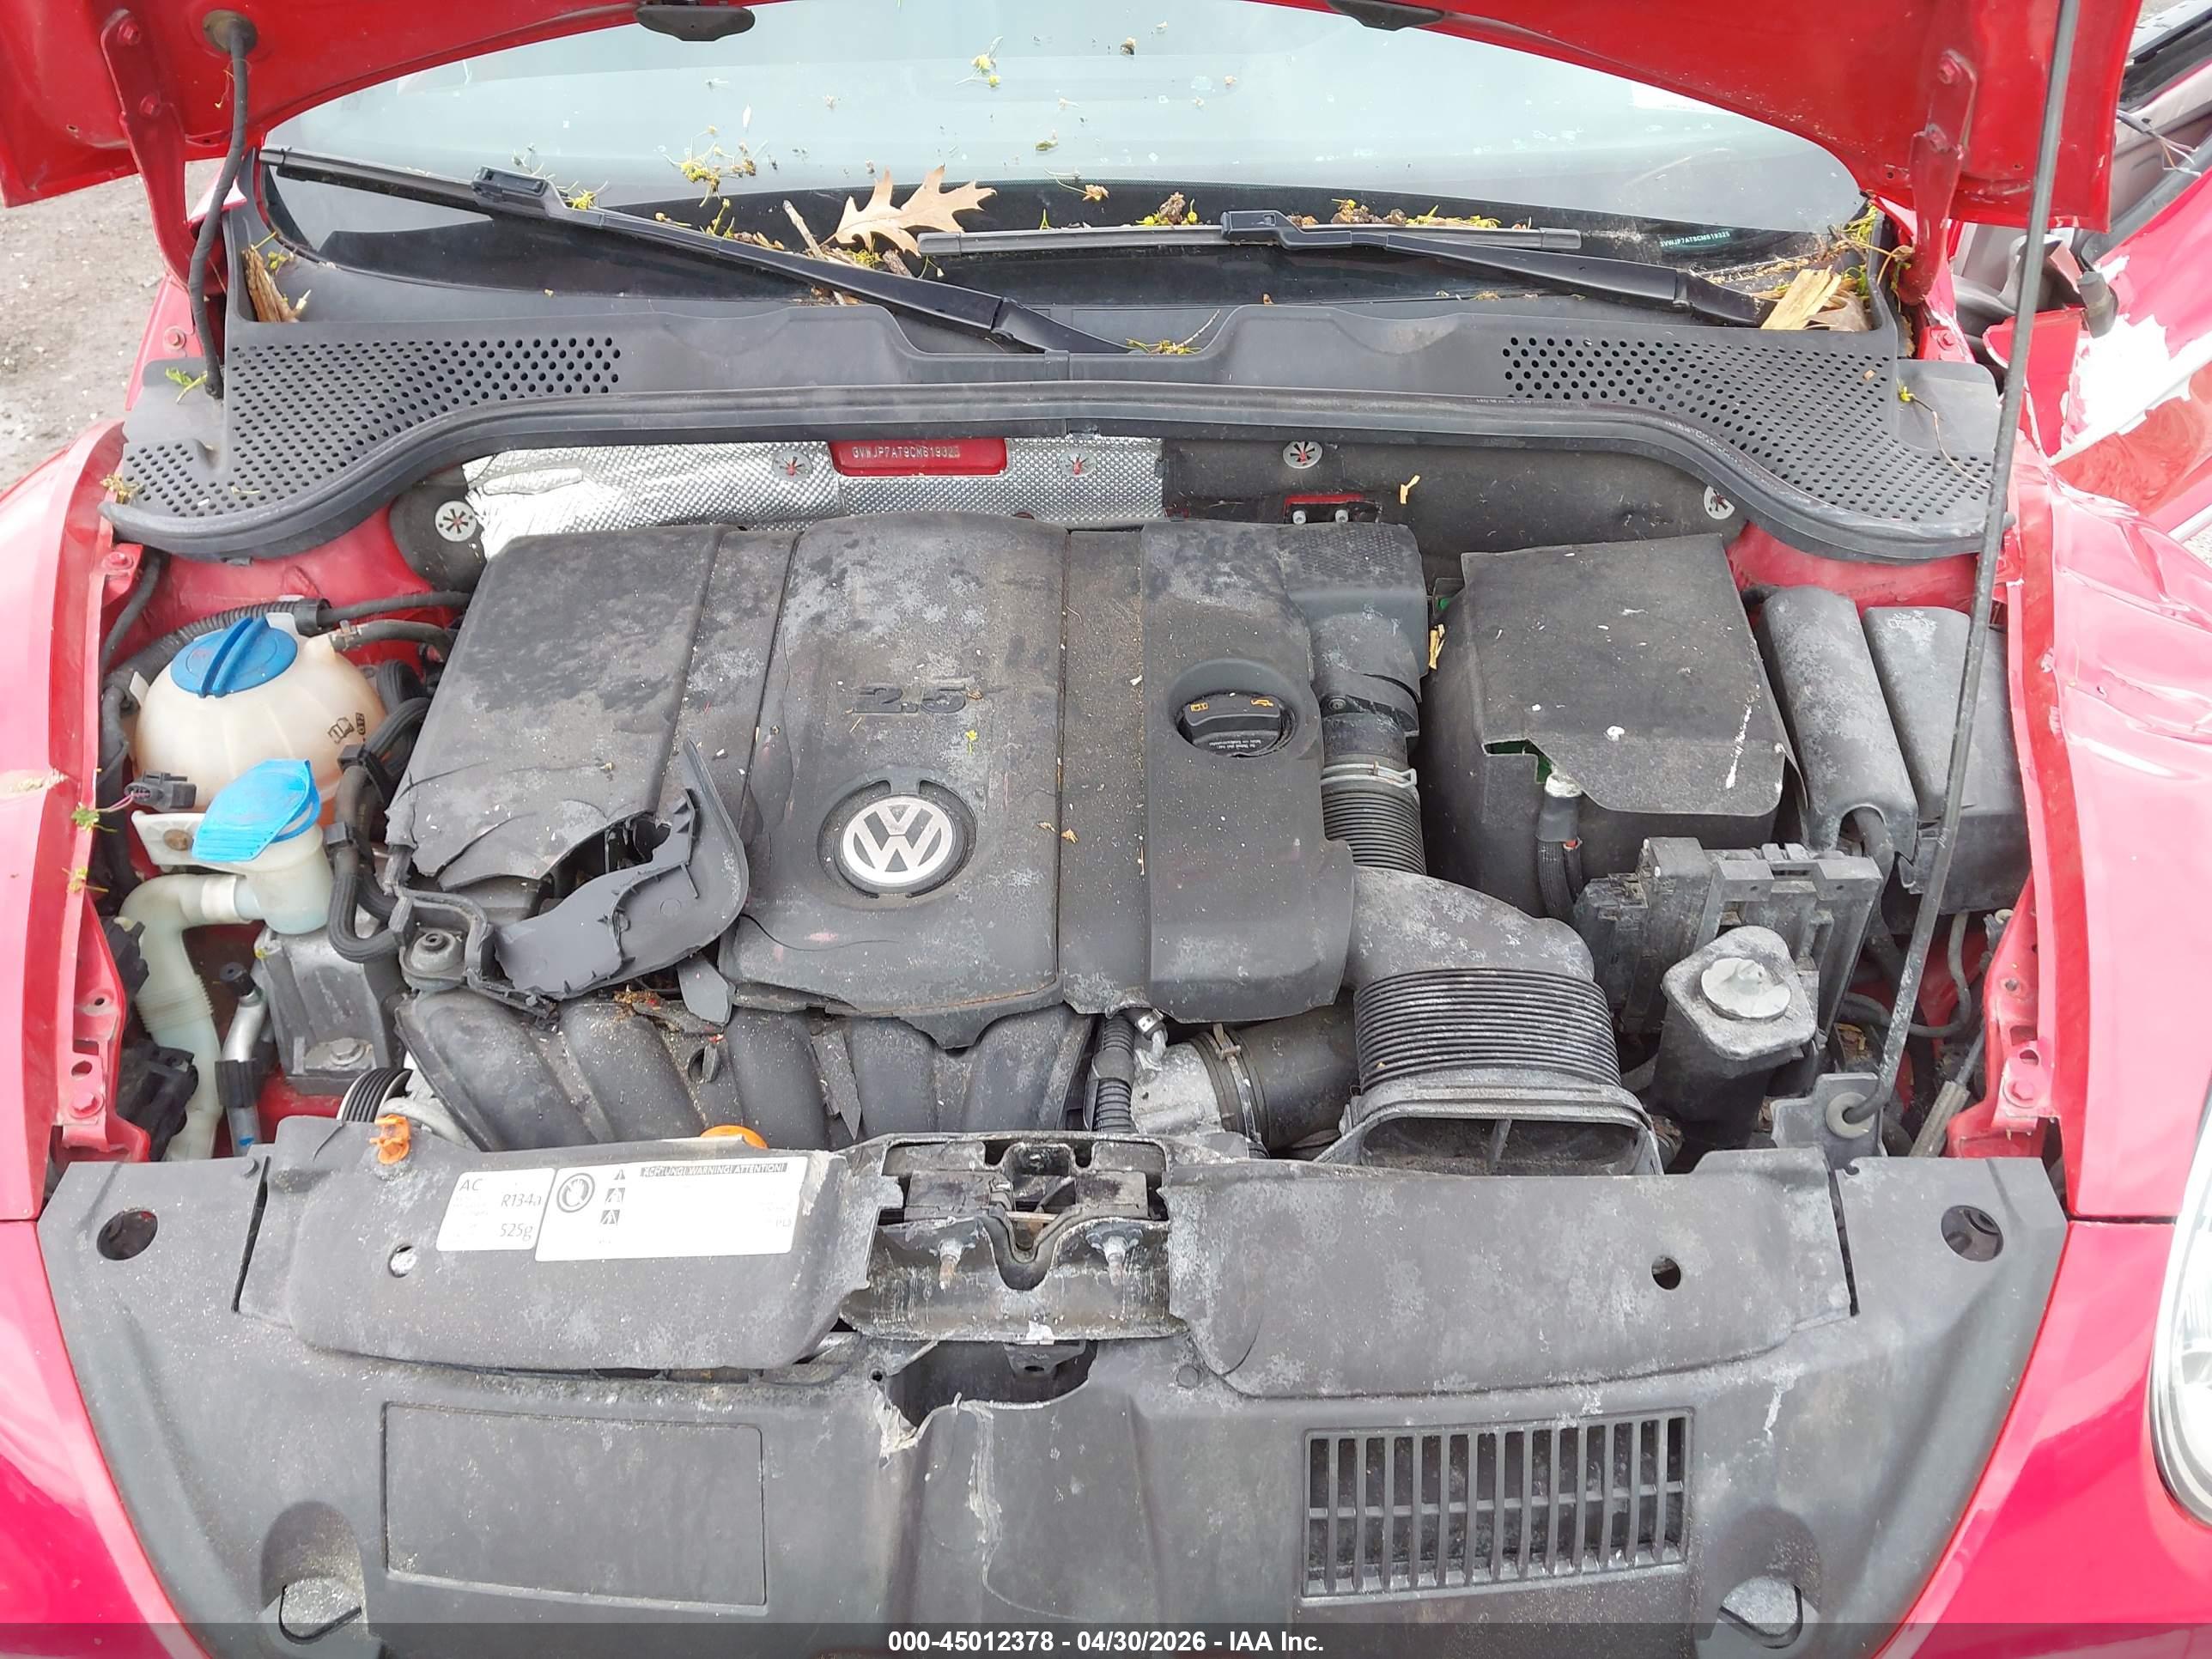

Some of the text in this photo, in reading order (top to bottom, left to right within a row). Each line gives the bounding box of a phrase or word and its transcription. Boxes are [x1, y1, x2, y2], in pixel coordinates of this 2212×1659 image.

[853, 684, 967, 714] 2.5
[843, 796, 954, 885] VW
[733, 1163, 786, 1174] ATTENTION!
[459, 1178, 483, 1192] AC
